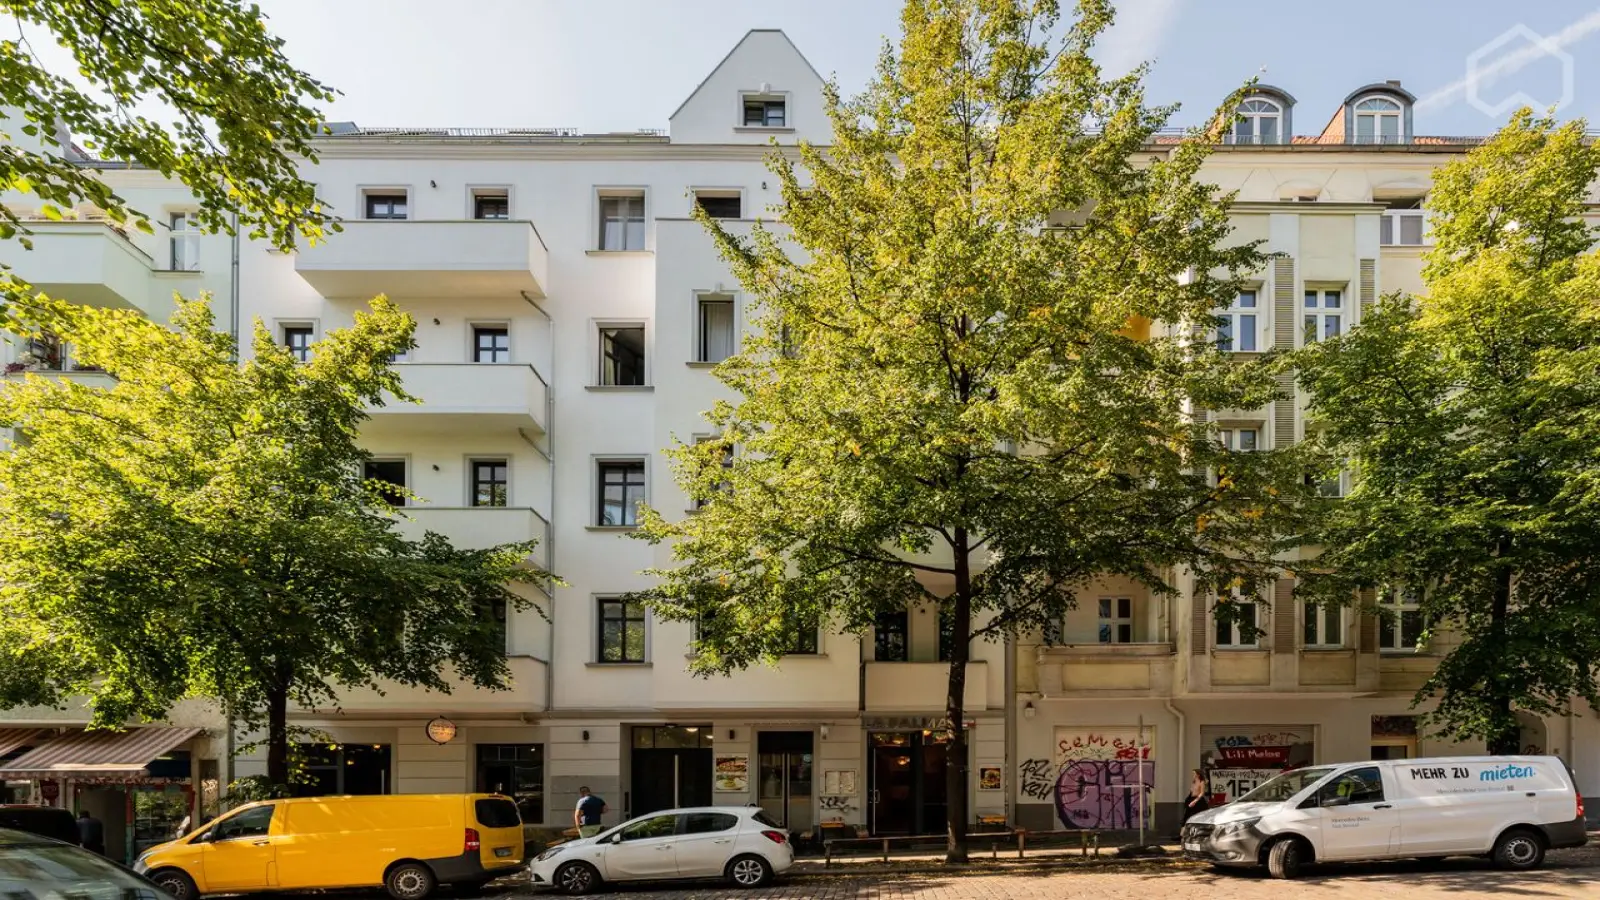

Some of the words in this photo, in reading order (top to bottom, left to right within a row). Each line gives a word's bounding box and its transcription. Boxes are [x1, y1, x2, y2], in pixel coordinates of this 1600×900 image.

[1225, 749, 1245, 759] Lili
[1410, 767, 1447, 780] MEHR
[1451, 767, 1469, 779] ZU
